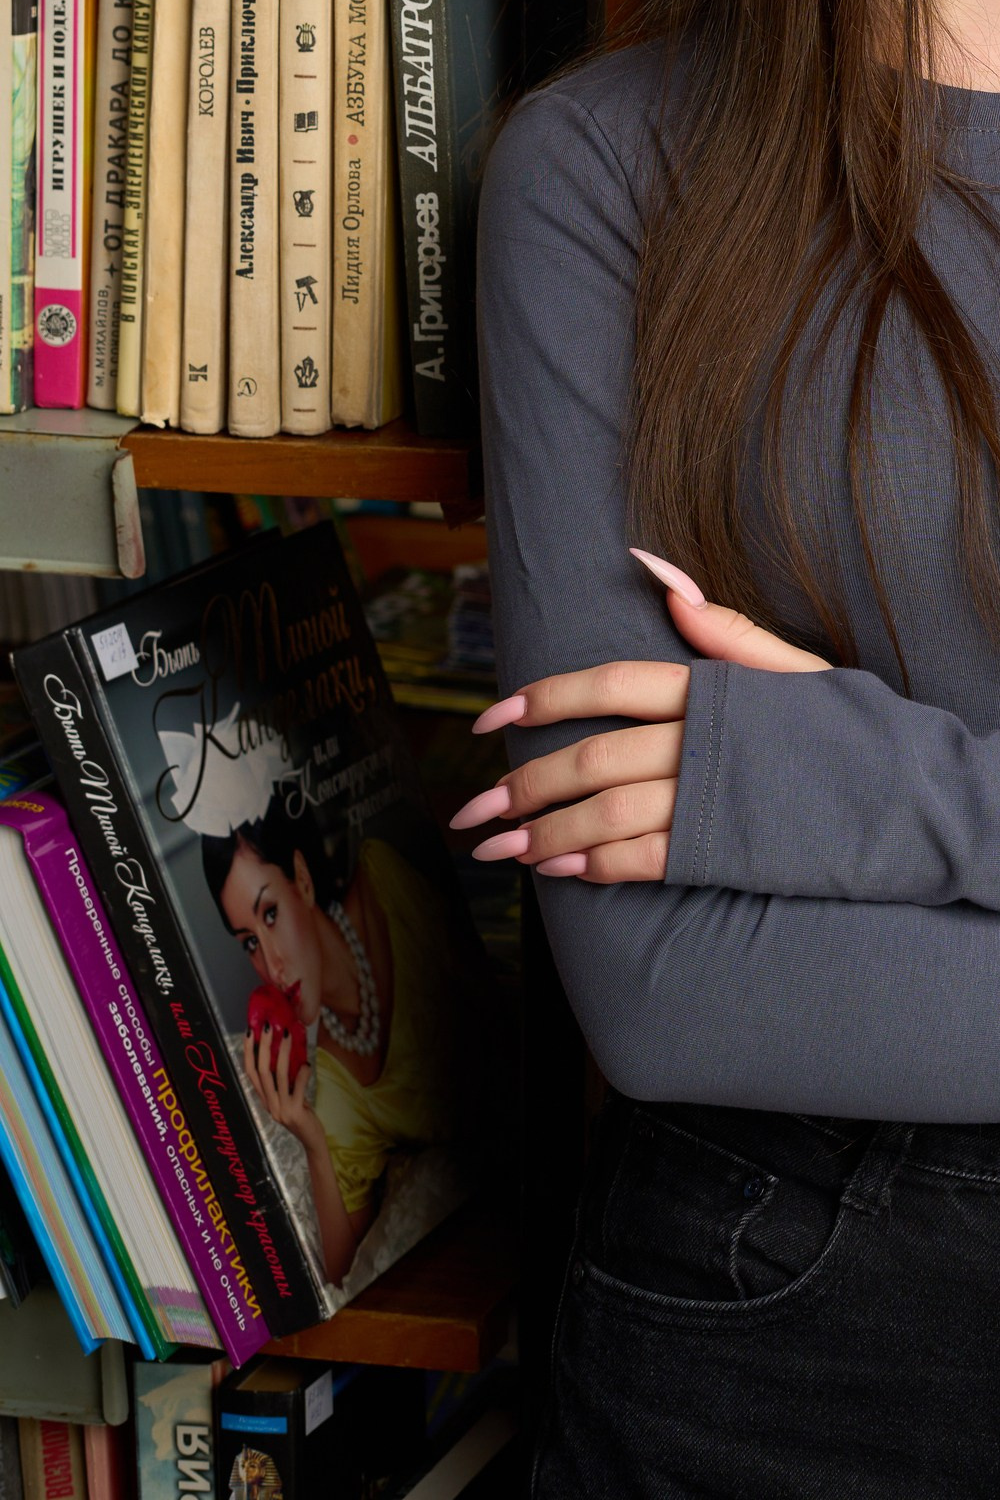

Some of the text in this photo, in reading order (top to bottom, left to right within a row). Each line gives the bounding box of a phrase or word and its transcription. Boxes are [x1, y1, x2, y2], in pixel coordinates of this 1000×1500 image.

[53, 64, 65, 78] И
[112, 25, 132, 66] ДО
[199, 26, 215, 117] КОРОЛЕВ
[346, 32, 367, 127] АЗБУКА
[52, 84, 66, 191] ИГРУШЕК
[106, 78, 130, 209] ДРАКАРА
[236, 111, 255, 164] Ивич
[235, 172, 259, 280] Александр
[343, 158, 365, 231] Орлова
[103, 219, 123, 251] ОТ
[121, 227, 139, 305] ПОИСКАХ
[341, 236, 364, 305] Лидия
[413, 191, 449, 342] Григорьев
[120, 311, 136, 323] В
[415, 347, 446, 382] А.
[131, 629, 201, 687] Быть
[43, 673, 293, 1299] Быть Тиной Канделаки, или Конструктор красоты
[65, 847, 121, 981] Проверенные
[118, 984, 155, 1067] способы
[108, 1002, 247, 1332] заболеваний, опасных и не очень
[176, 1425, 212, 1500] ИЯ
